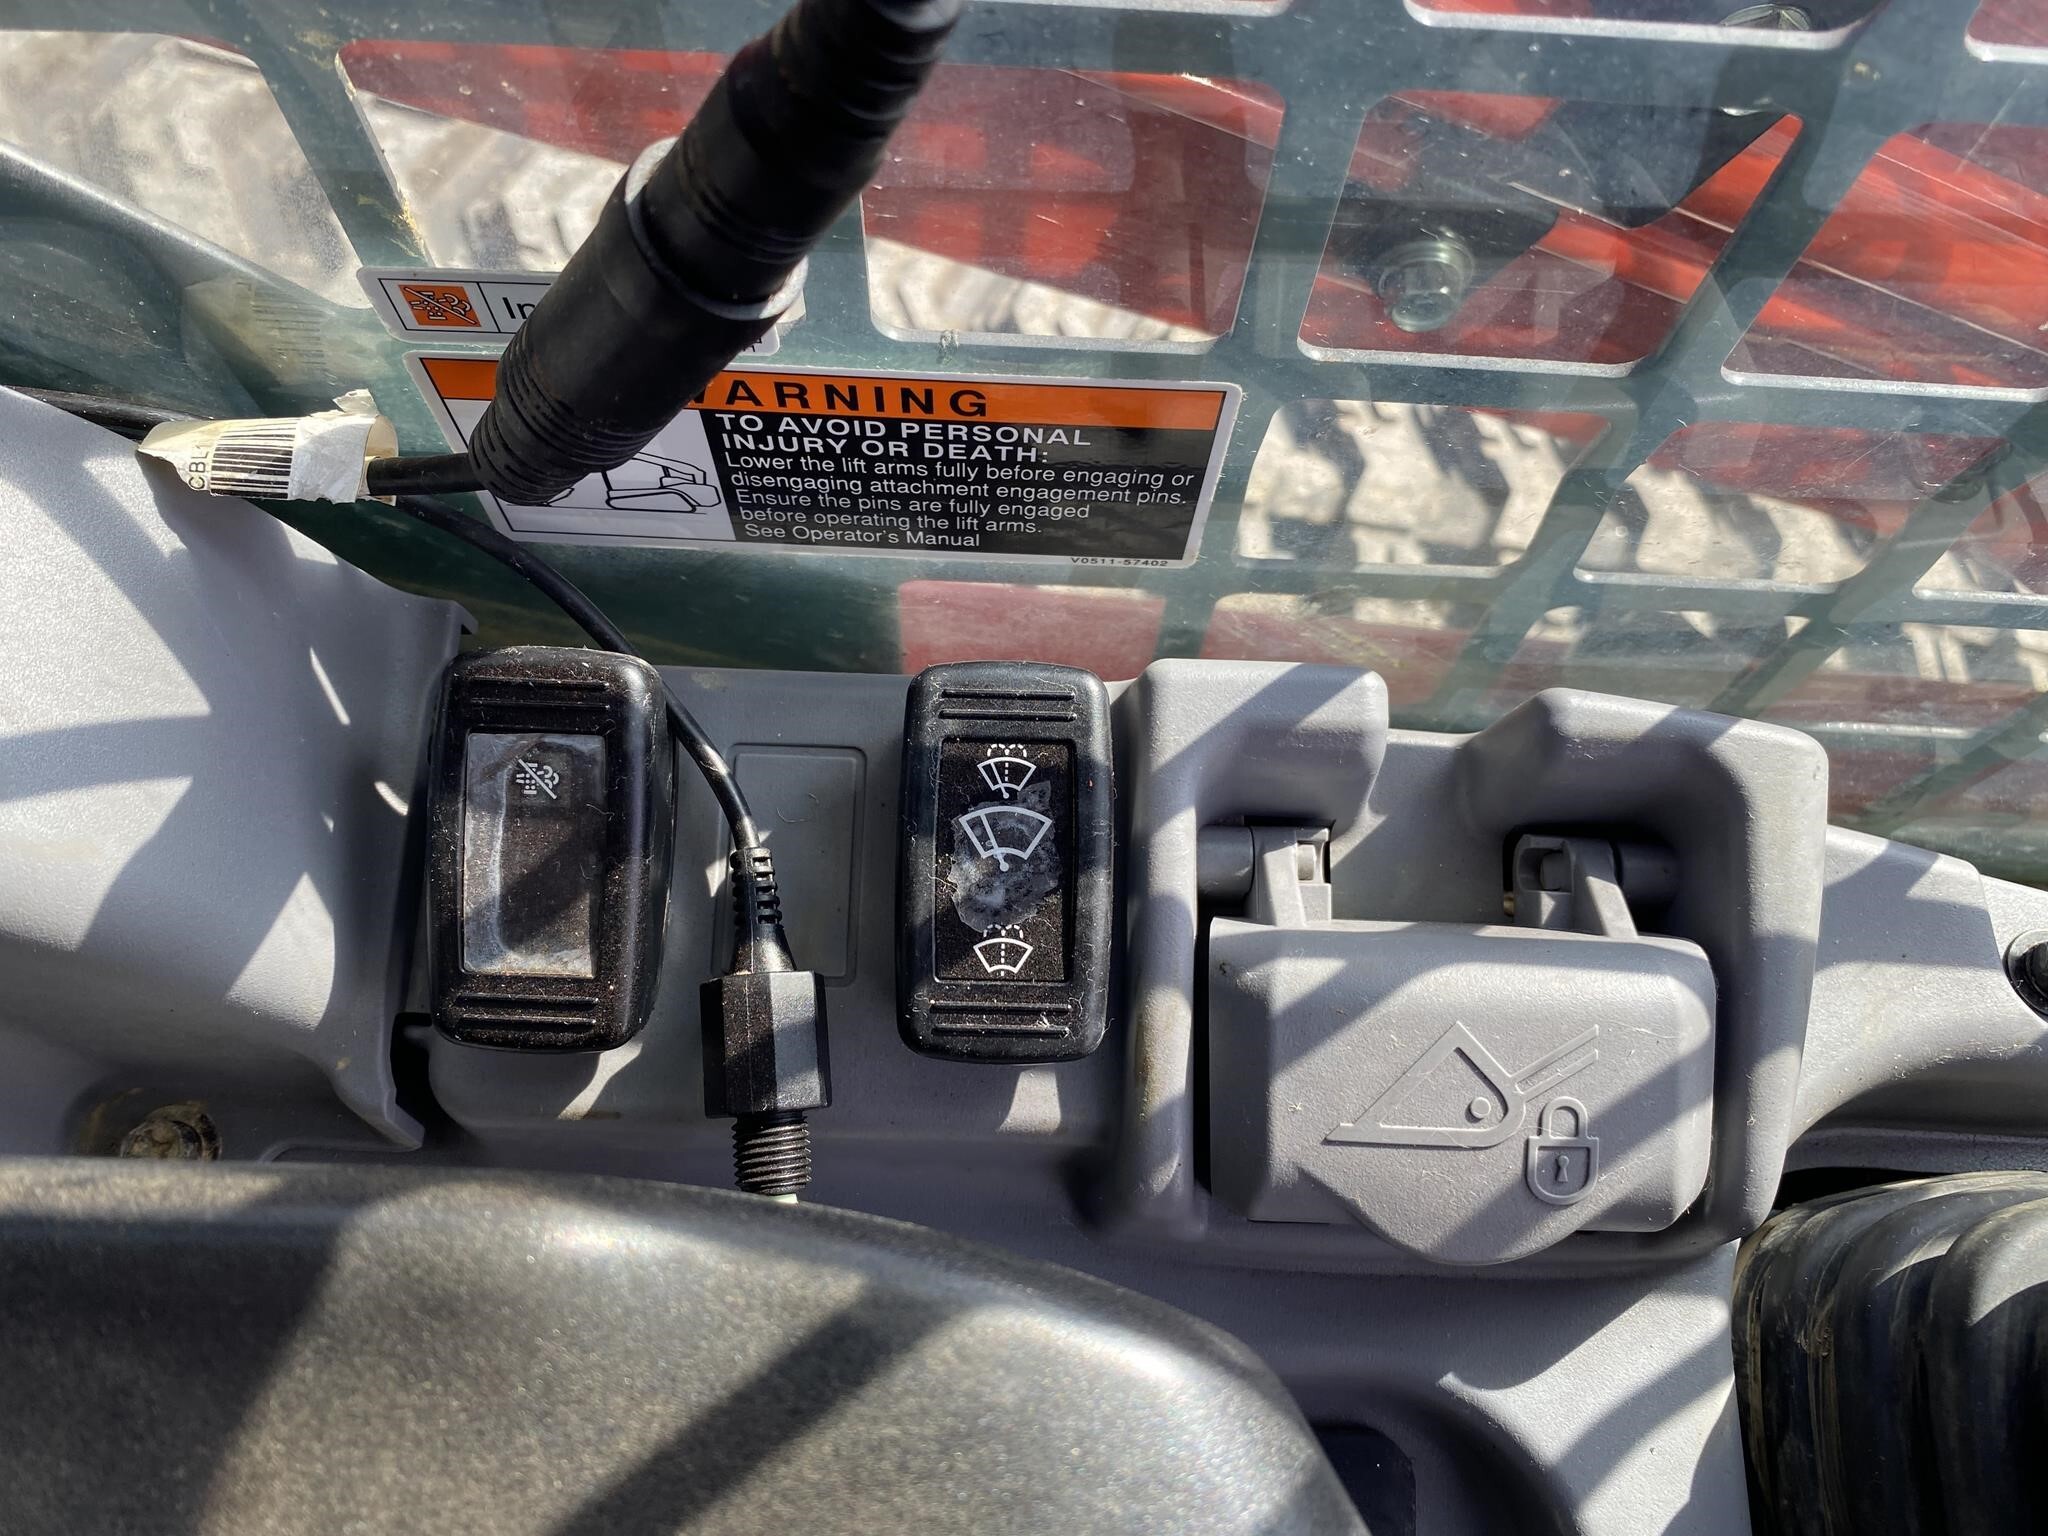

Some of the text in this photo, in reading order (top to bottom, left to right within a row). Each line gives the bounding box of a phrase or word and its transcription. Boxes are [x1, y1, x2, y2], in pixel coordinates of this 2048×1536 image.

[692, 379, 987, 418] ARNING
[715, 413, 1091, 446] TO AVOID PERSONAL
[721, 433, 1048, 463] INJURY OR DEATH:
[725, 452, 1194, 488] Lower the lift arms fully before engaging or
[731, 471, 1187, 506] disengaging attachment engagement pins.
[736, 489, 1090, 521] Ensure the pins are fully engaged
[740, 506, 1041, 534] before operating the lift arms.
[745, 524, 980, 547] See Operator's Manual
[1071, 557, 1168, 567] V0511-57402
